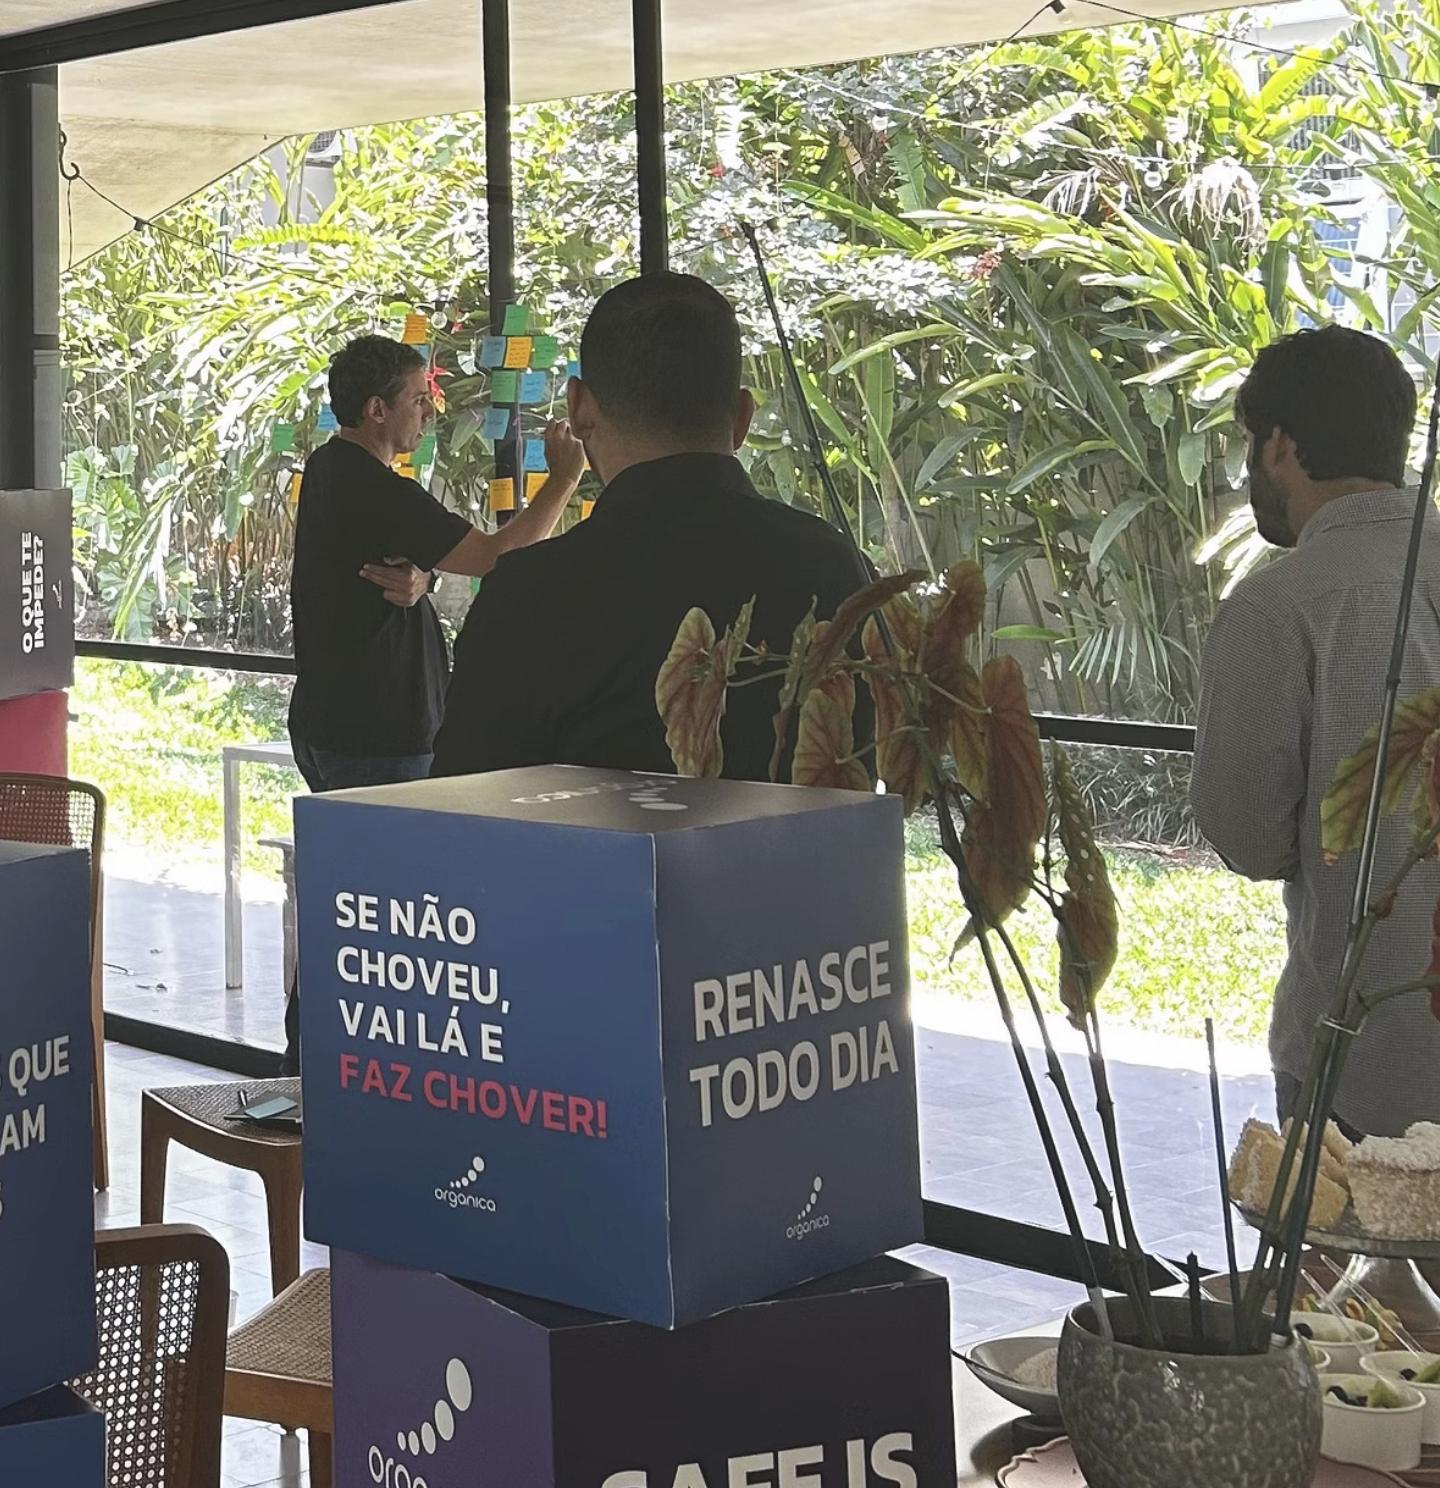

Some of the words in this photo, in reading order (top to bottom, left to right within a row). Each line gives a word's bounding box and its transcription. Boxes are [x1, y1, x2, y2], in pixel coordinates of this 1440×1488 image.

[21, 532, 32, 566] TE
[22, 570, 35, 627] QUE
[33, 535, 44, 648] IMPEDE?
[22, 632, 33, 653] O
[336, 892, 378, 932] SE
[390, 893, 476, 945] NÃO
[336, 946, 510, 1014] CHOVEU,
[693, 940, 892, 1042] RENASCE
[338, 999, 406, 1046] VAI
[417, 1005, 469, 1057] LÁ
[480, 1023, 504, 1063] E
[9, 1035, 70, 1097] QUE
[340, 1053, 412, 1102] FAZ
[423, 1070, 608, 1139] CHOVER!
[689, 1041, 821, 1127] TODO
[830, 1020, 900, 1092] DIA
